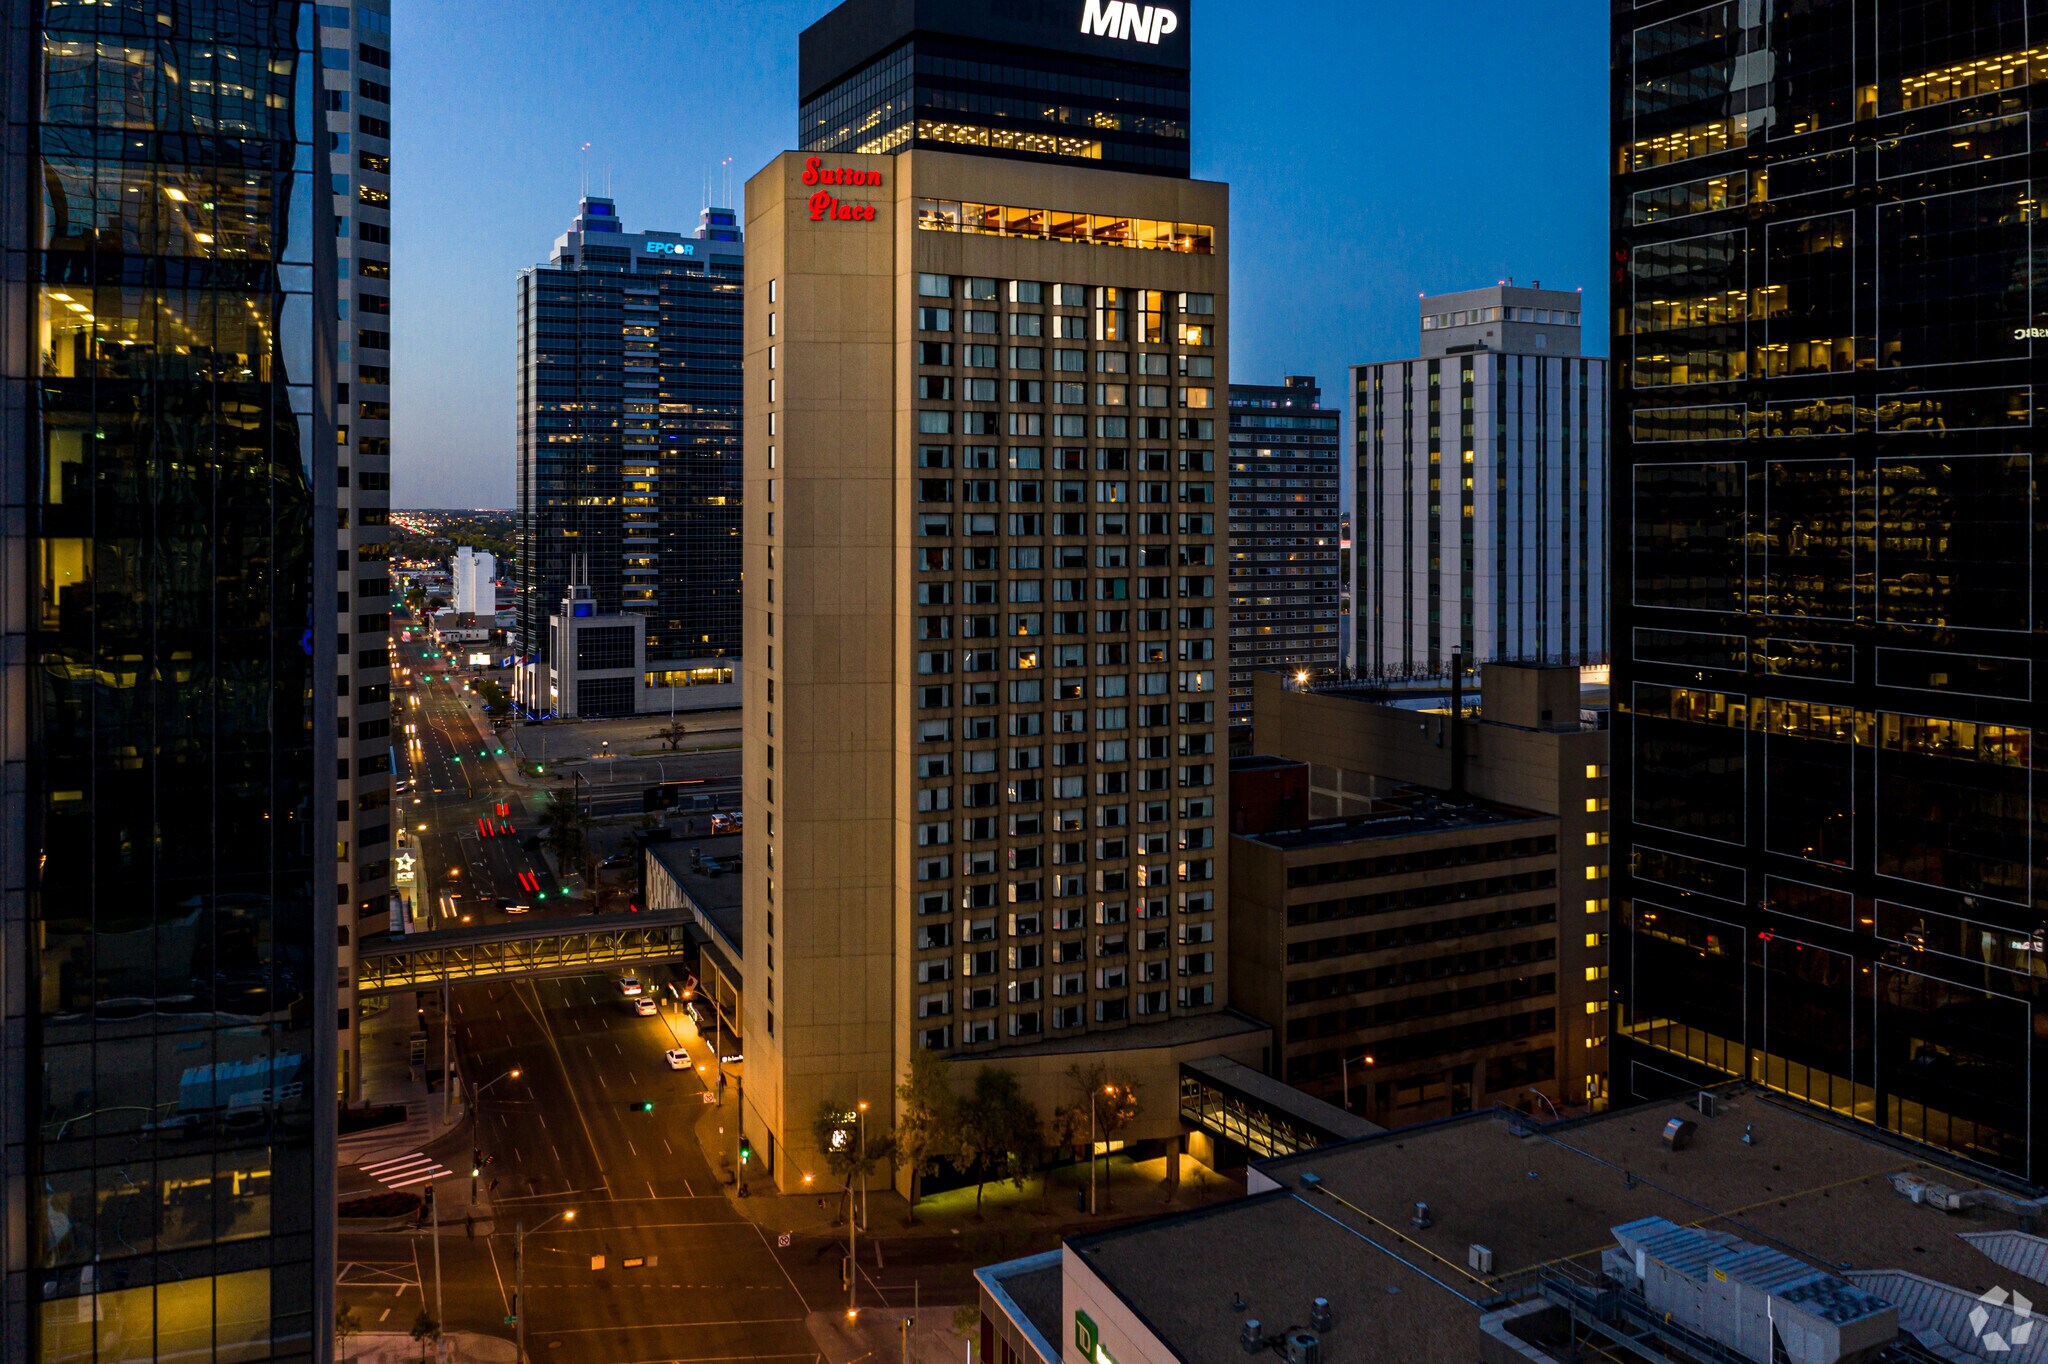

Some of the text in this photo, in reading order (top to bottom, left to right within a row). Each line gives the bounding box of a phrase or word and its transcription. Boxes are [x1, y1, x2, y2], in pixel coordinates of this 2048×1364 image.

[1080, 0, 1178, 45] MNP
[802, 156, 881, 186] Sutton
[808, 189, 876, 221] Place
[646, 241, 694, 256] EPCOR
[1076, 1320, 1091, 1354] TD
